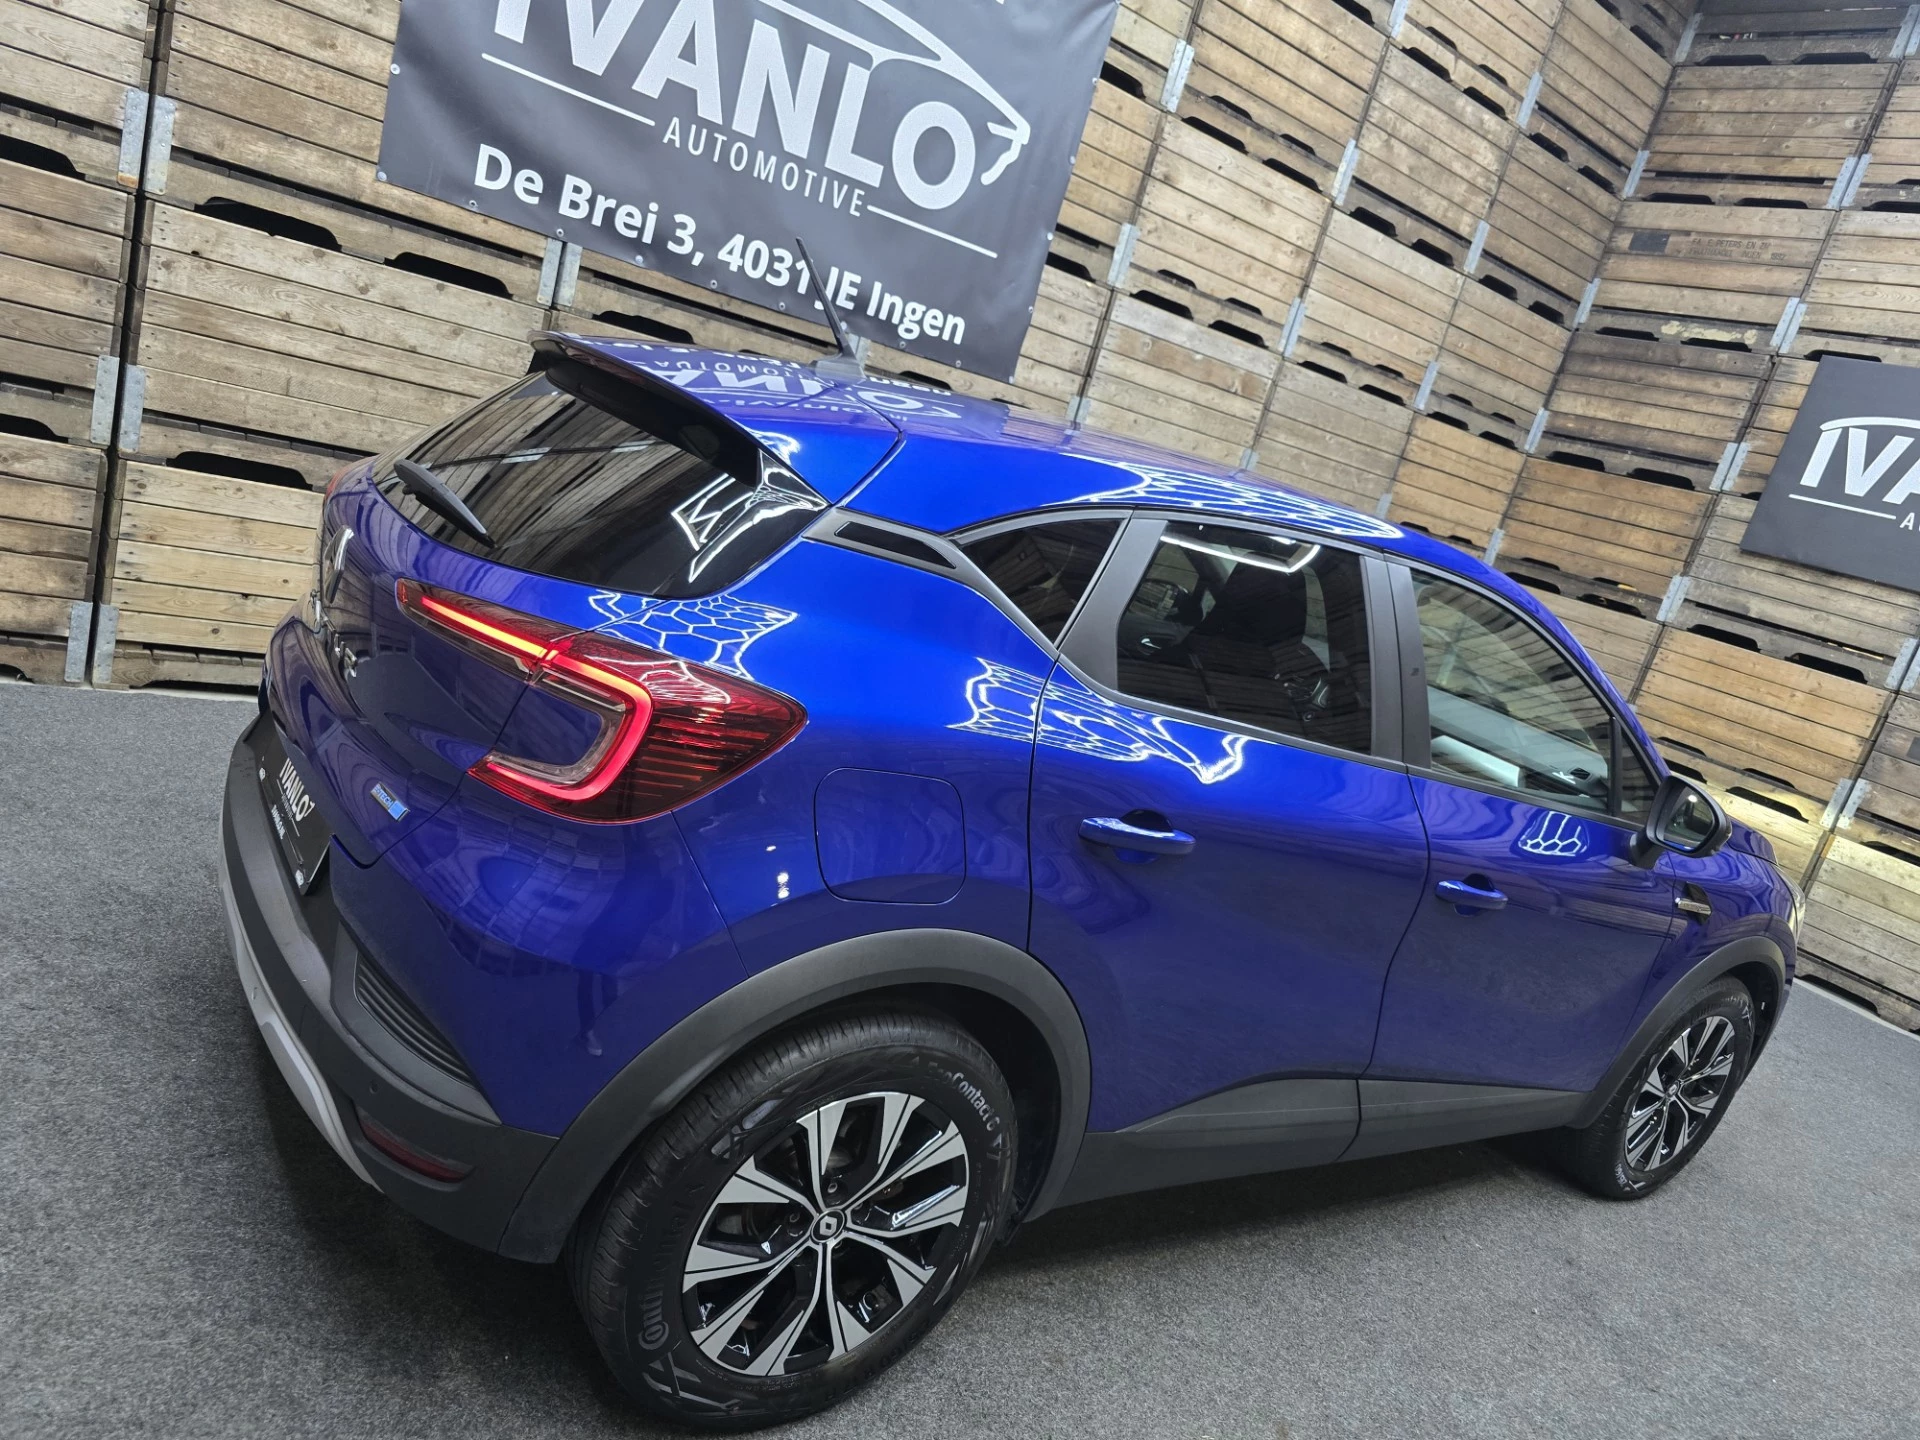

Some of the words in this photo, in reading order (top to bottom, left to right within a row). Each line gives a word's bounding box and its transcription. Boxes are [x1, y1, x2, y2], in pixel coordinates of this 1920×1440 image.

[662, 116, 865, 217] AUTOMOTIVE
[474, 143, 544, 205] De
[558, 174, 659, 245] Brei
[666, 213, 705, 267] 3,
[717, 233, 814, 295] 4031
[814, 266, 862, 311] JE
[866, 281, 966, 345] Ingen
[279, 757, 310, 822] IVANLO
